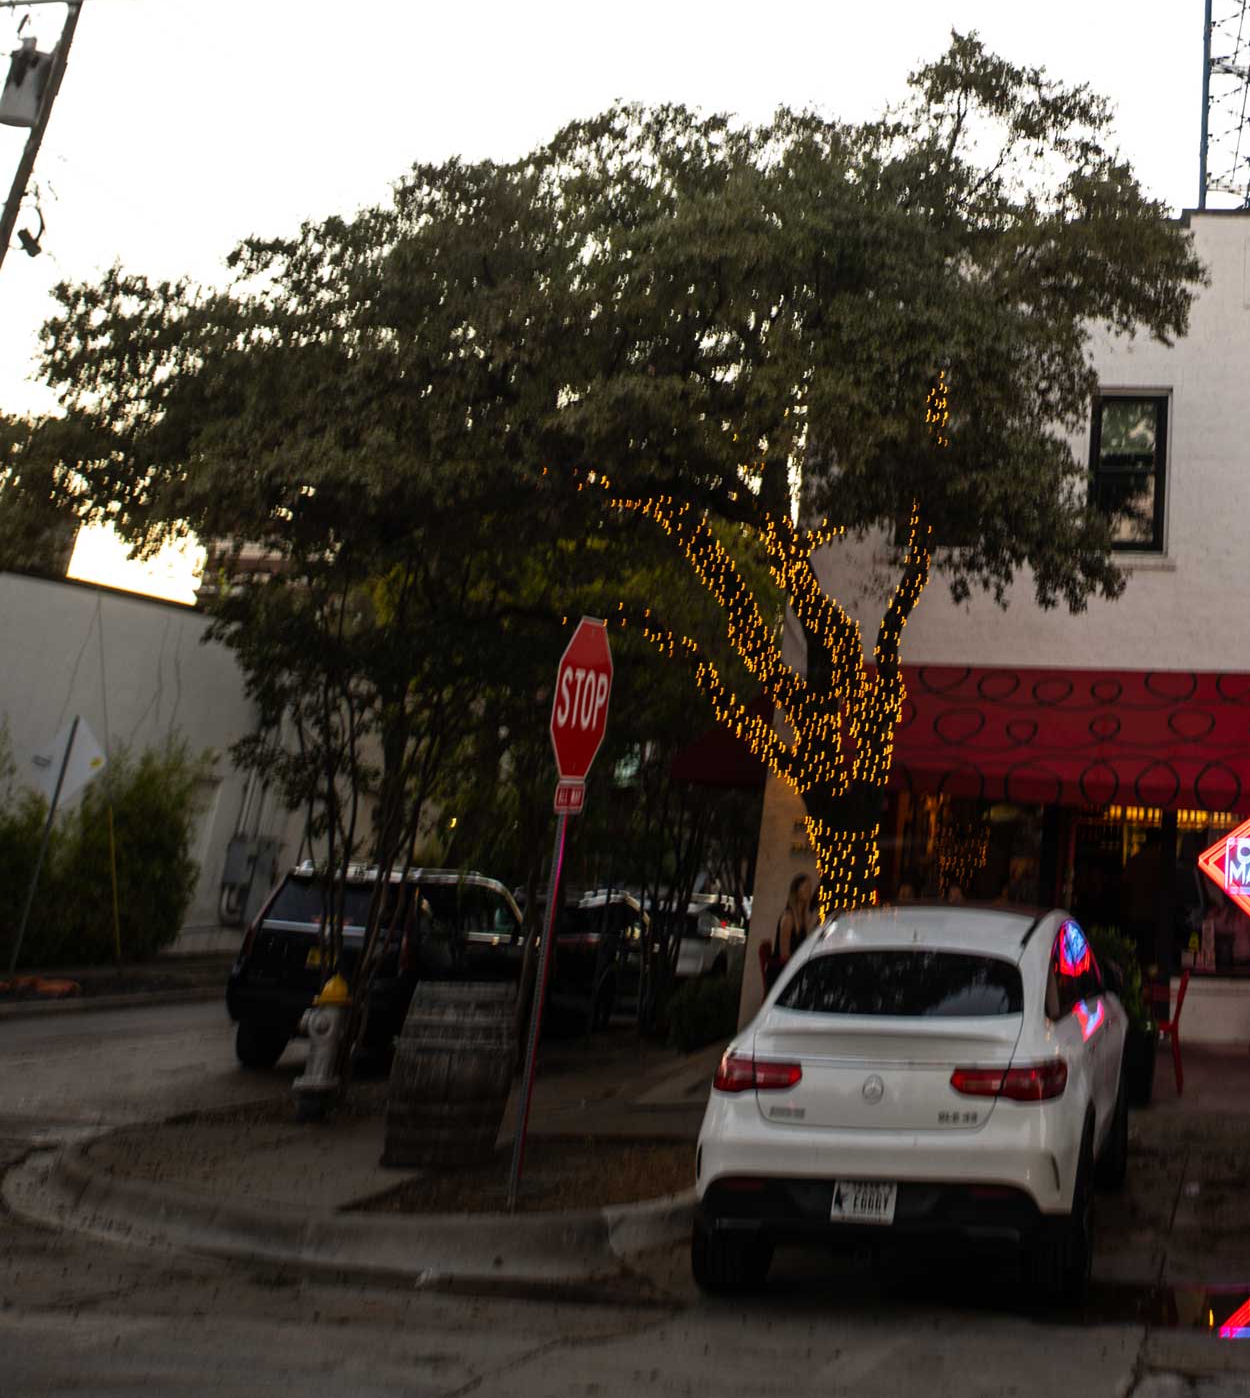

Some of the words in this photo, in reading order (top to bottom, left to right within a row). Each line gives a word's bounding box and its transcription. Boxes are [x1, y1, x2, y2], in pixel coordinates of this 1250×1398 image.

[557, 665, 608, 731] STOP
[559, 787, 570, 804] ALL
[570, 788, 583, 805] WAY
